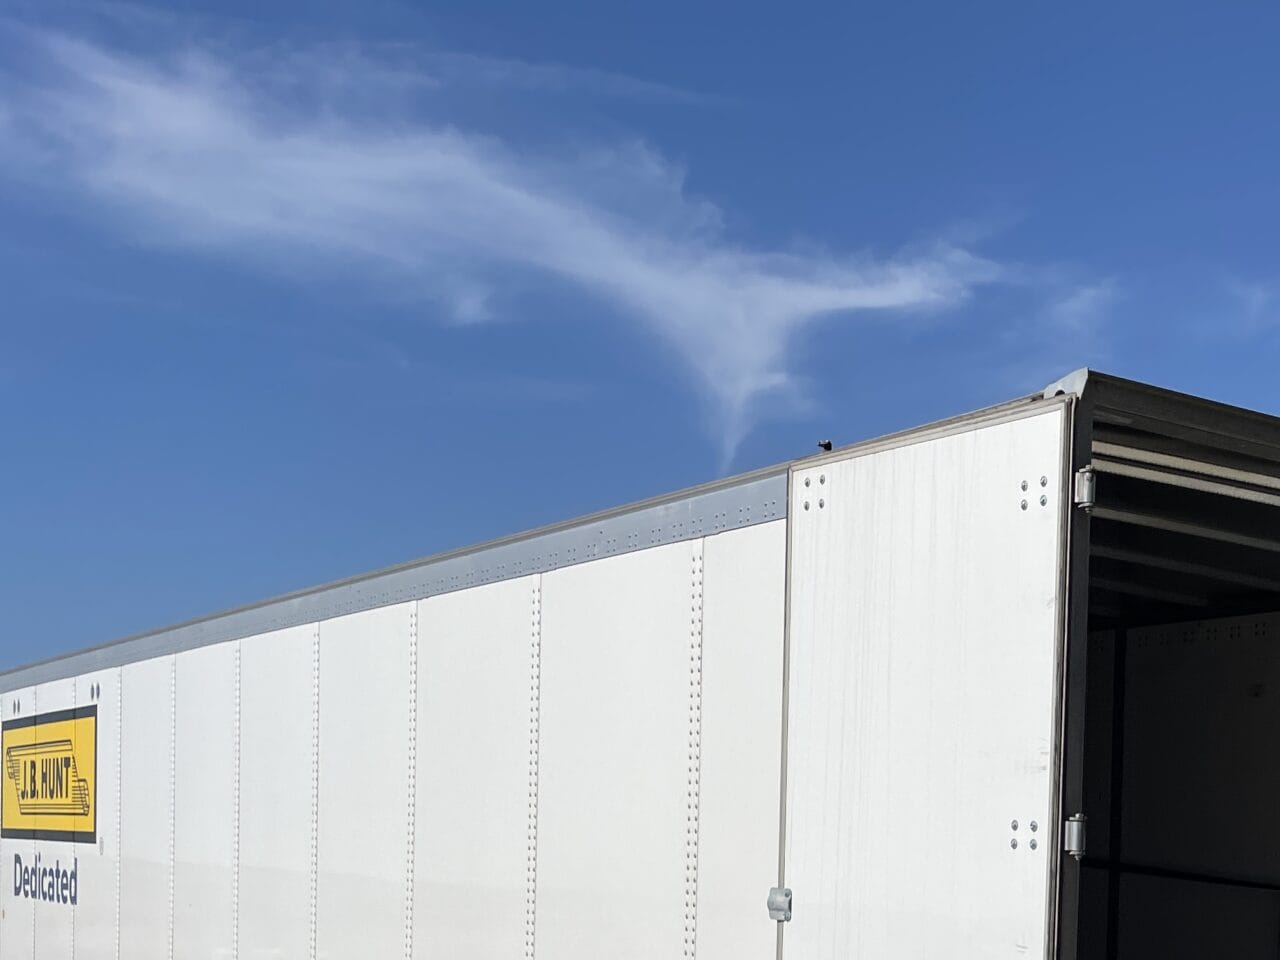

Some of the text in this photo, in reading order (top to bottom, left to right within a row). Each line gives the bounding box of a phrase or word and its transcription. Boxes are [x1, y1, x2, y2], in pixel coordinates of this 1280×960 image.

[21, 757, 71, 800] J.B. HUNT
[14, 852, 78, 906] Dedicated
